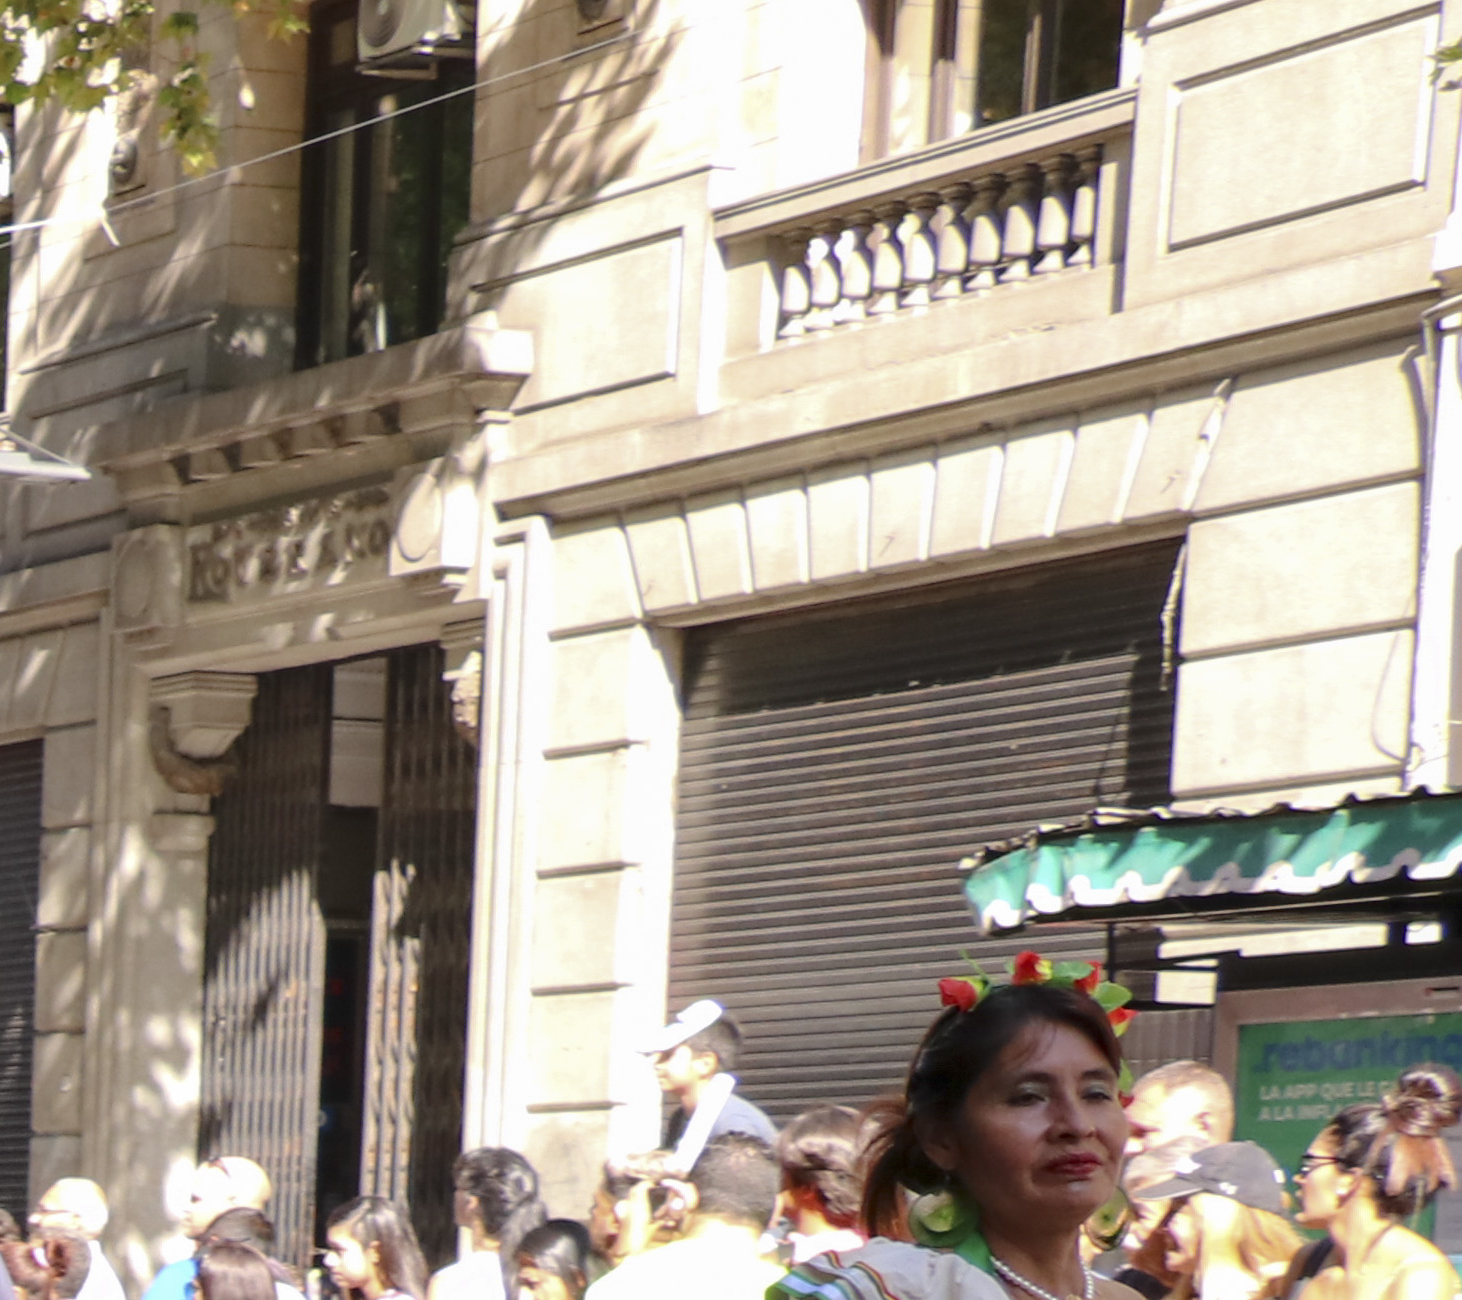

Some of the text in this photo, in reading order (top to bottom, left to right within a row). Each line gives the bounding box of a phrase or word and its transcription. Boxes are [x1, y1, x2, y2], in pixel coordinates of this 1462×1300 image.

[1260, 1085, 1278, 1101] LA
[1283, 1083, 1315, 1100] APP
[1319, 1081, 1353, 1101] QUE
[1358, 1081, 1375, 1098] LE
[1274, 1105, 1294, 1121] LA
